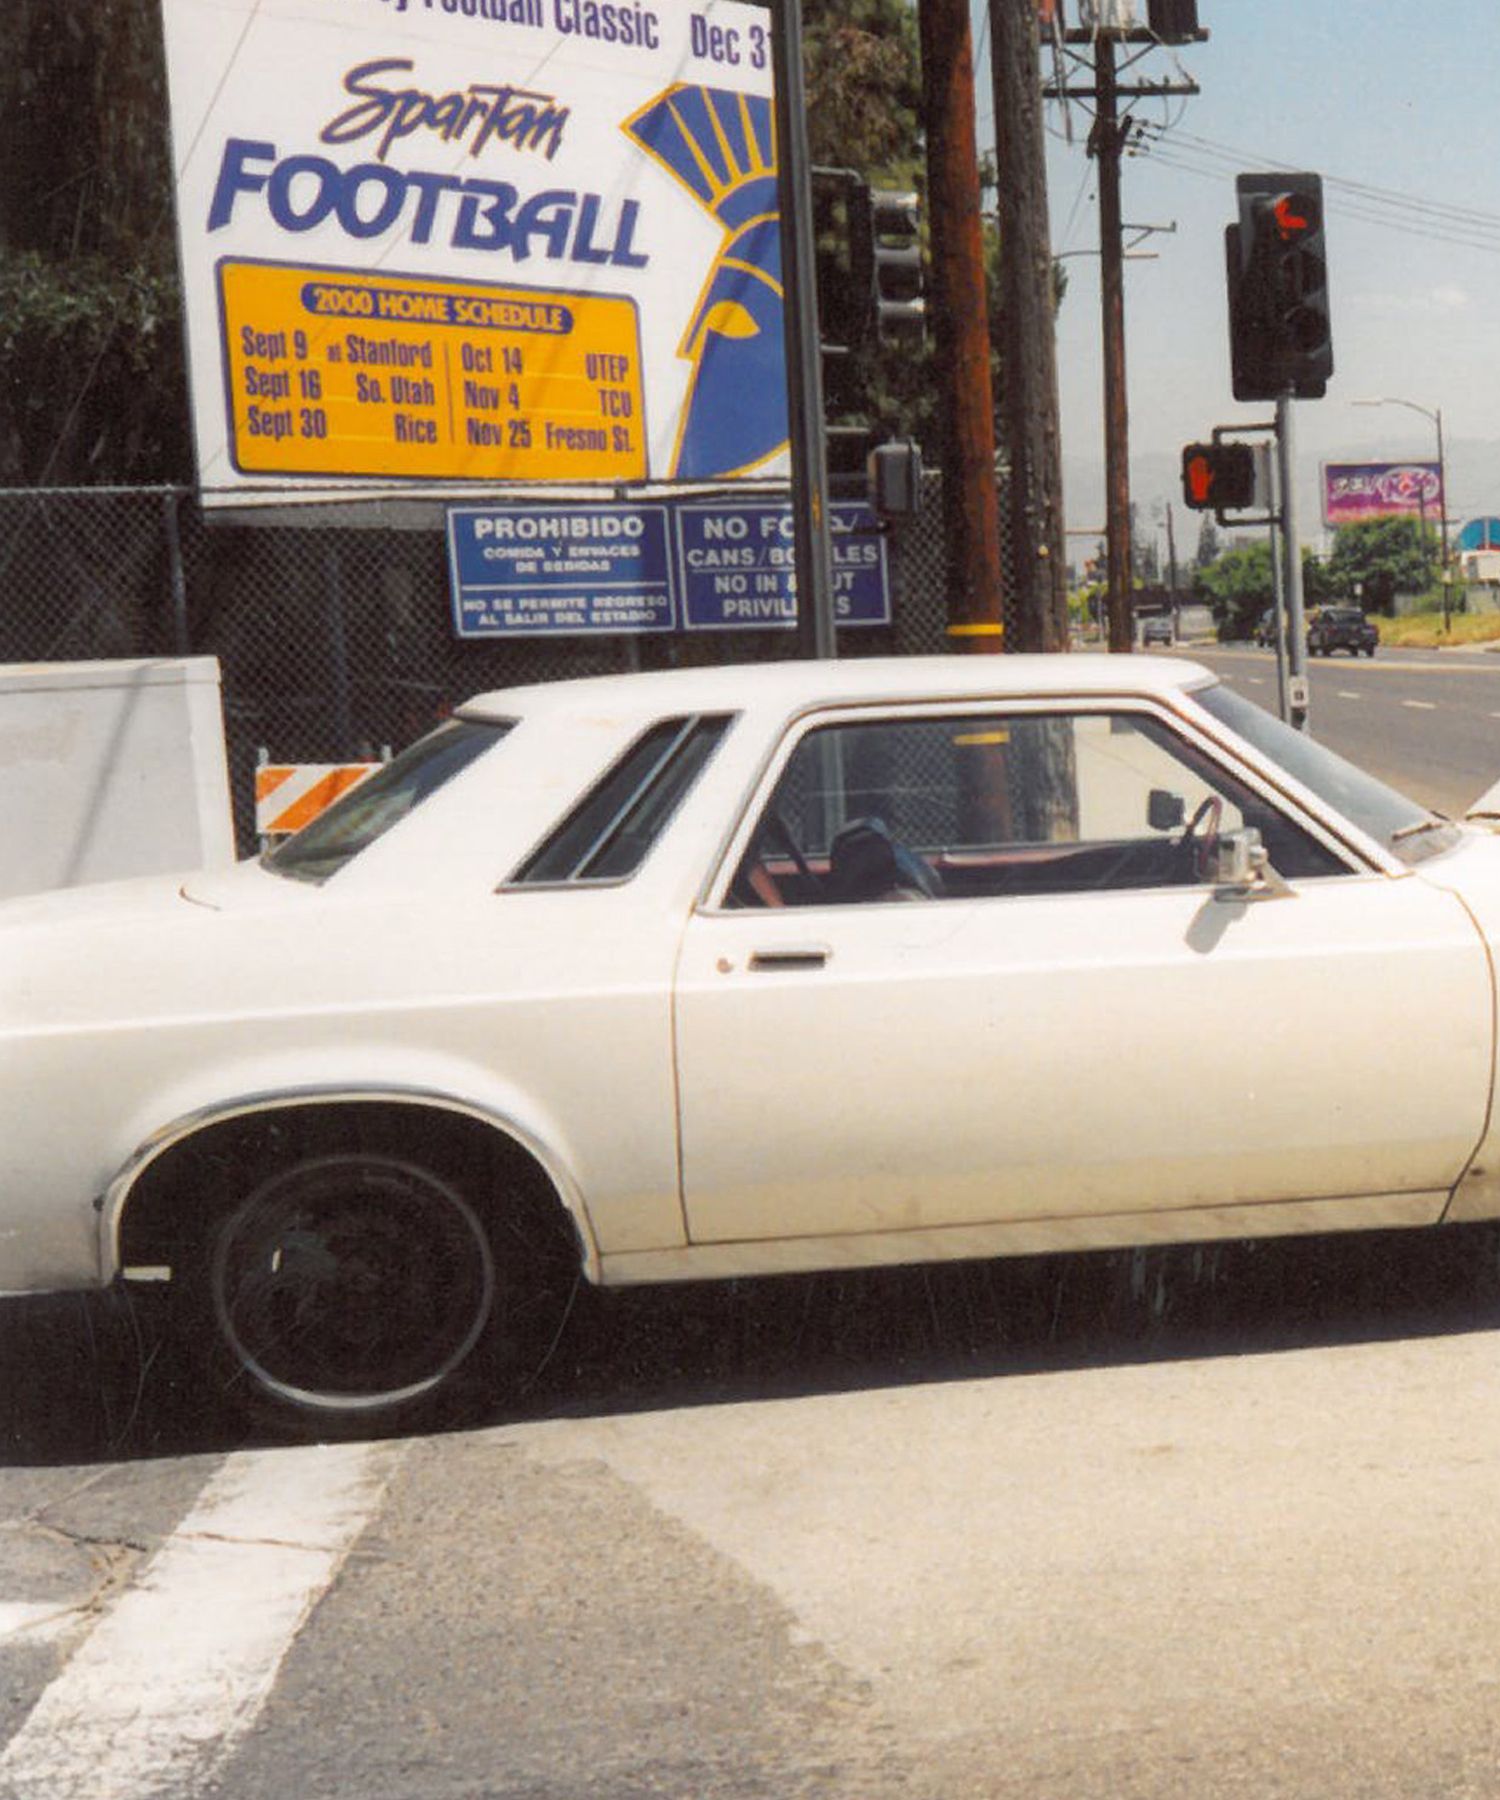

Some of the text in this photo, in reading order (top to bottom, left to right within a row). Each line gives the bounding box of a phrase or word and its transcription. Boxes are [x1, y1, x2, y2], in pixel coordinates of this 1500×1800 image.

[424, 0, 771, 70] otball Classic Dec 3
[319, 57, 571, 162] Spartan
[207, 137, 650, 269] FOOTBALL
[313, 287, 564, 331] 2000 HOME SCHEDULE
[241, 325, 287, 362] Sept
[293, 329, 308, 360] 9
[346, 333, 433, 369] Stanford
[461, 342, 630, 383] Oct 14 UTEP
[244, 365, 435, 407] Sept 16 So. Utah
[463, 380, 632, 418] Nov 4 TCU
[248, 405, 438, 445] Sept 30 Rice
[467, 416, 636, 453] Nov 25 Fresno St.
[474, 515, 646, 540] PROHIBIDO
[704, 516, 748, 539] NO
[483, 547, 546, 560] COMIDA
[515, 560, 611, 573] DE BEBIDAS
[715, 574, 747, 594] NO
[755, 574, 777, 592] IN
[463, 600, 486, 612] NO
[493, 598, 512, 611] SE
[519, 597, 587, 611] PERMITE
[478, 613, 499, 626] AL
[554, 611, 586, 624] DEL
